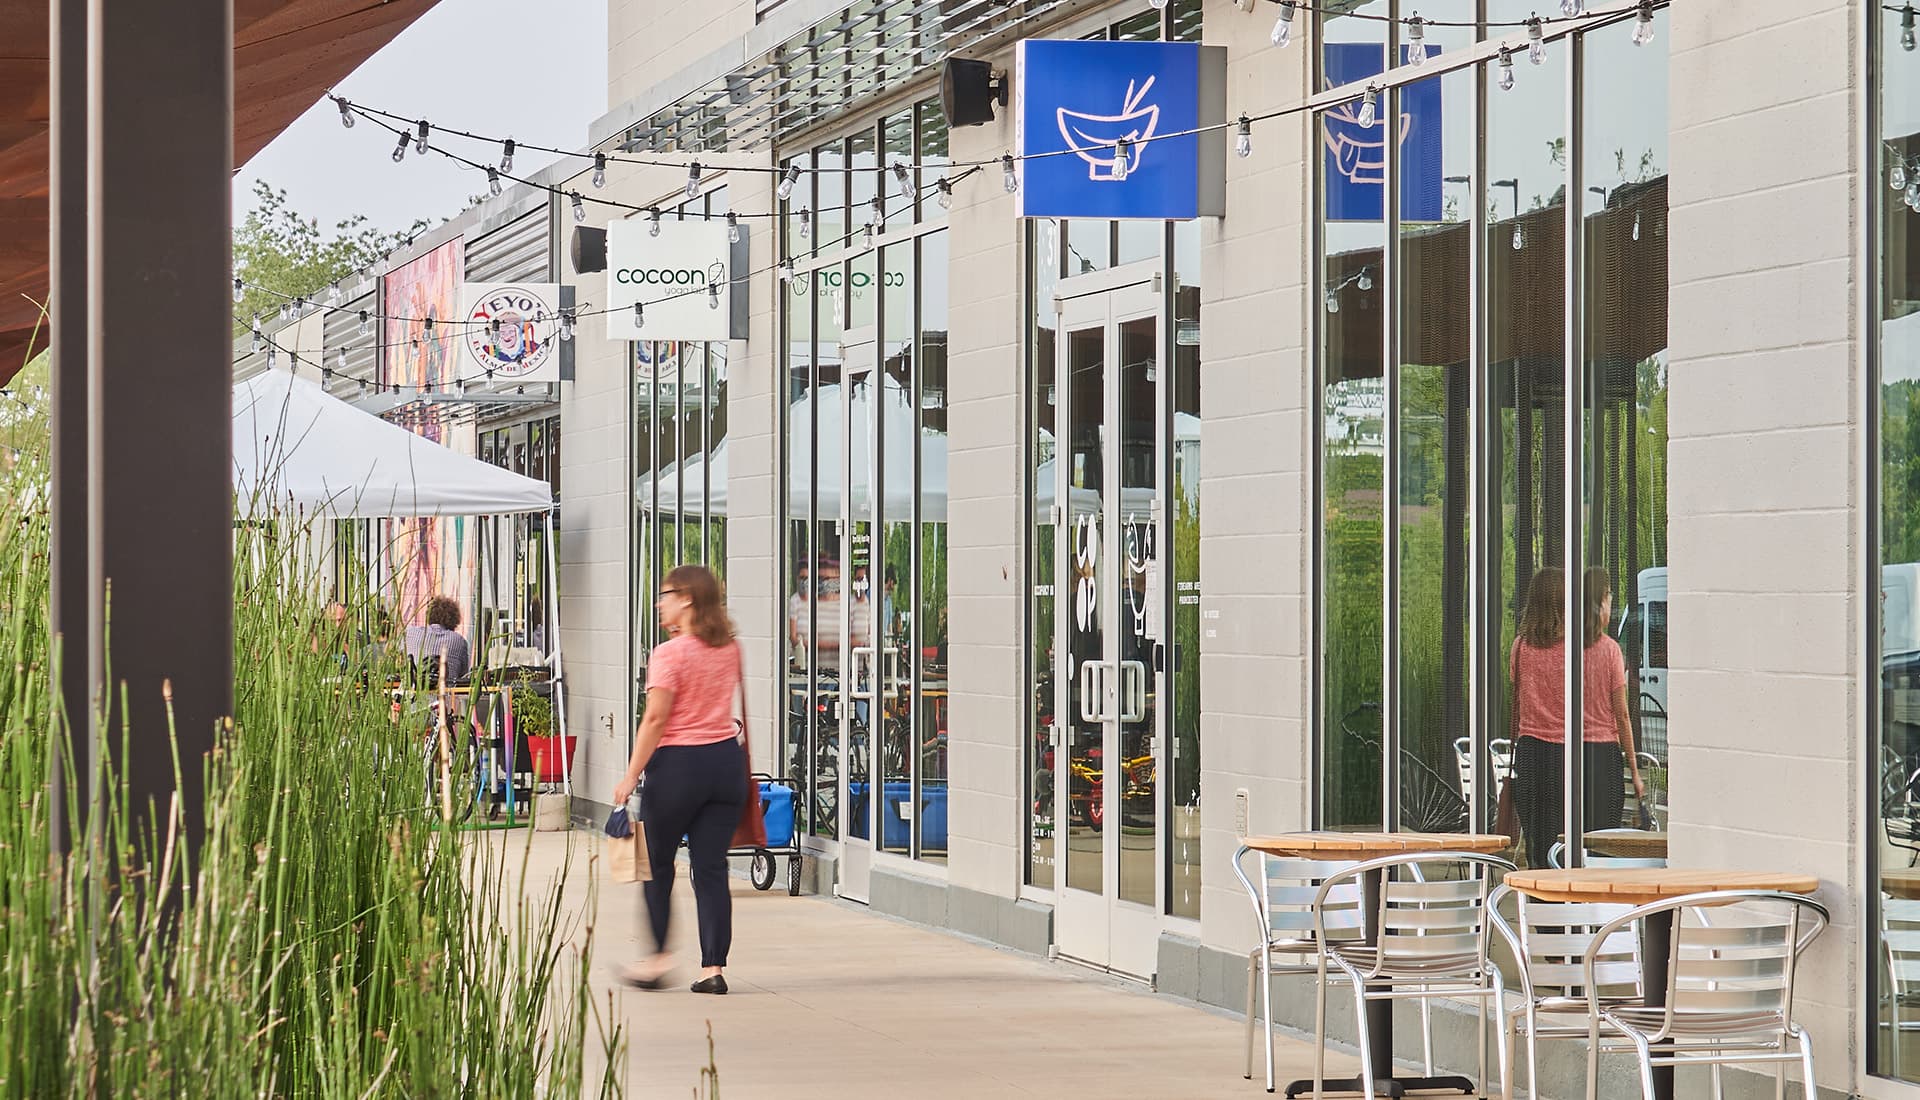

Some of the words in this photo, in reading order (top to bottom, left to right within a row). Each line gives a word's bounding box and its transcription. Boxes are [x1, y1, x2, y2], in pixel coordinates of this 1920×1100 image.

[616, 268, 705, 285] cocoon
[664, 287, 689, 297] yoga
[473, 295, 546, 324] YEYO'S
[522, 345, 546, 370] MEXIC
